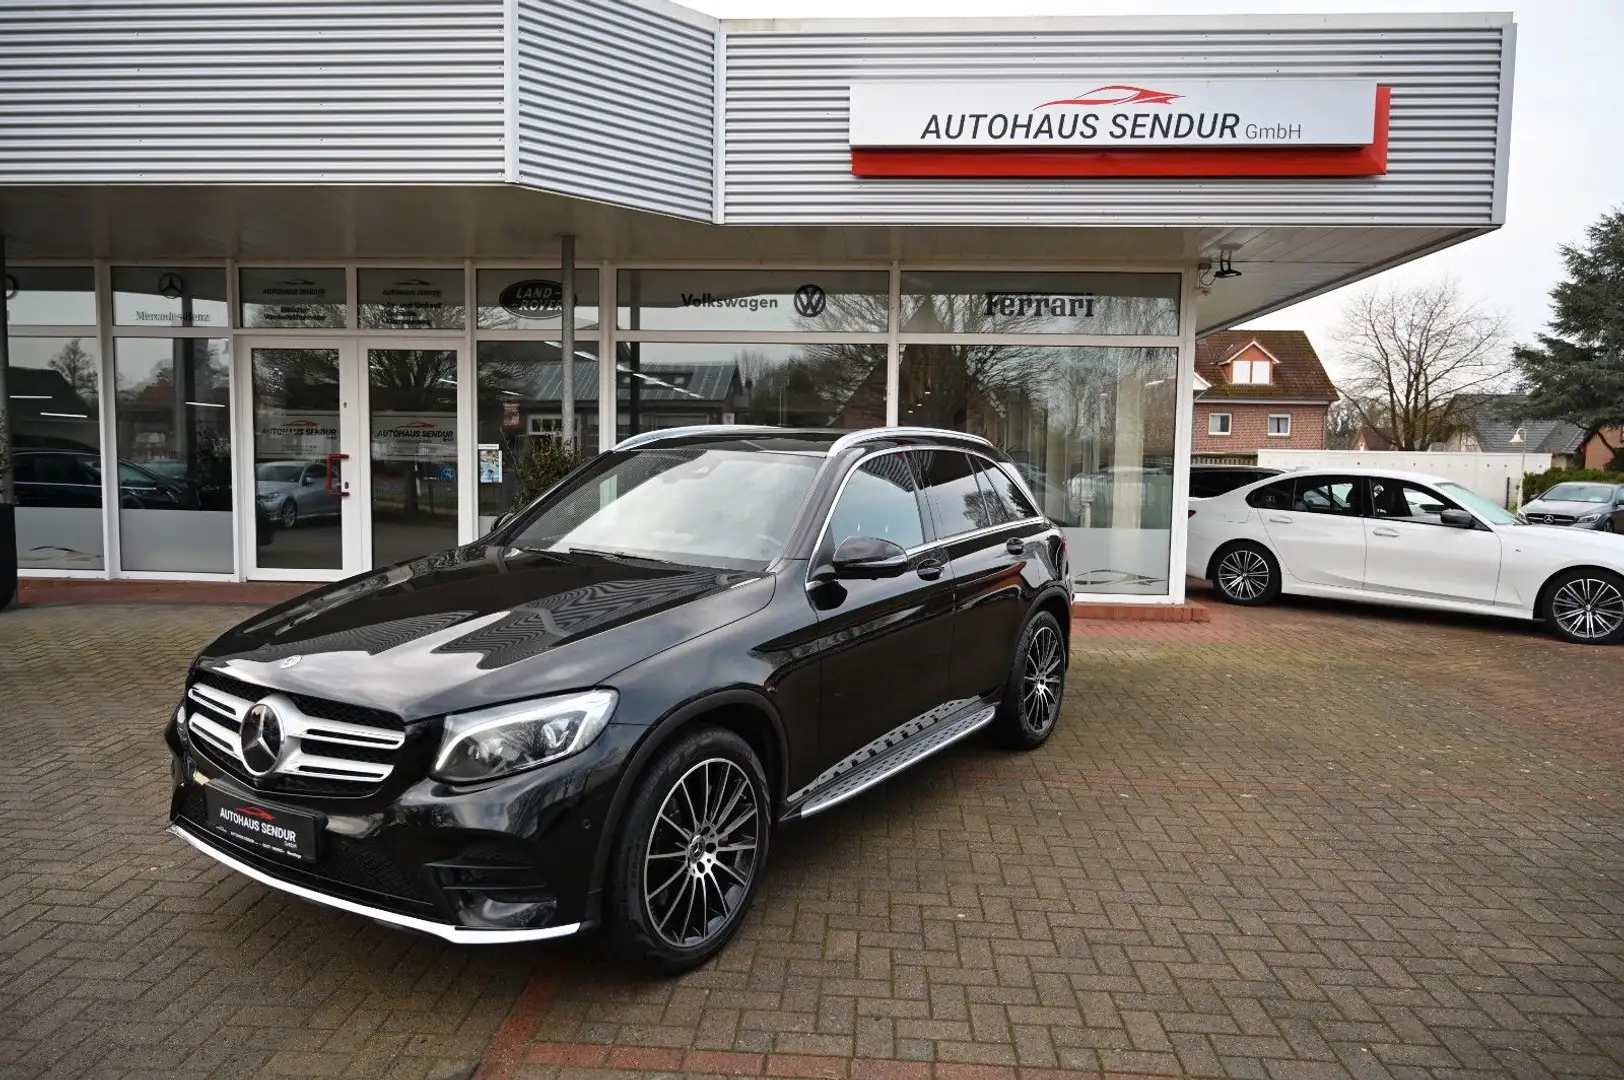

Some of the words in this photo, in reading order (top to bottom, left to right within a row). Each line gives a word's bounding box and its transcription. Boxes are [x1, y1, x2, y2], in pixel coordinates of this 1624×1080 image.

[920, 113, 1100, 139] AUTOHAUS
[1109, 113, 1240, 139] SENDUR
[1246, 123, 1302, 139] GmbH
[681, 292, 778, 311] Volkswagen
[984, 291, 1094, 317] Ferrari
[377, 430, 420, 438] AUTOHAUS
[422, 430, 454, 438] SENDUR
[220, 807, 260, 832] AUTOHAUS
[261, 822, 296, 842] SENDUR
